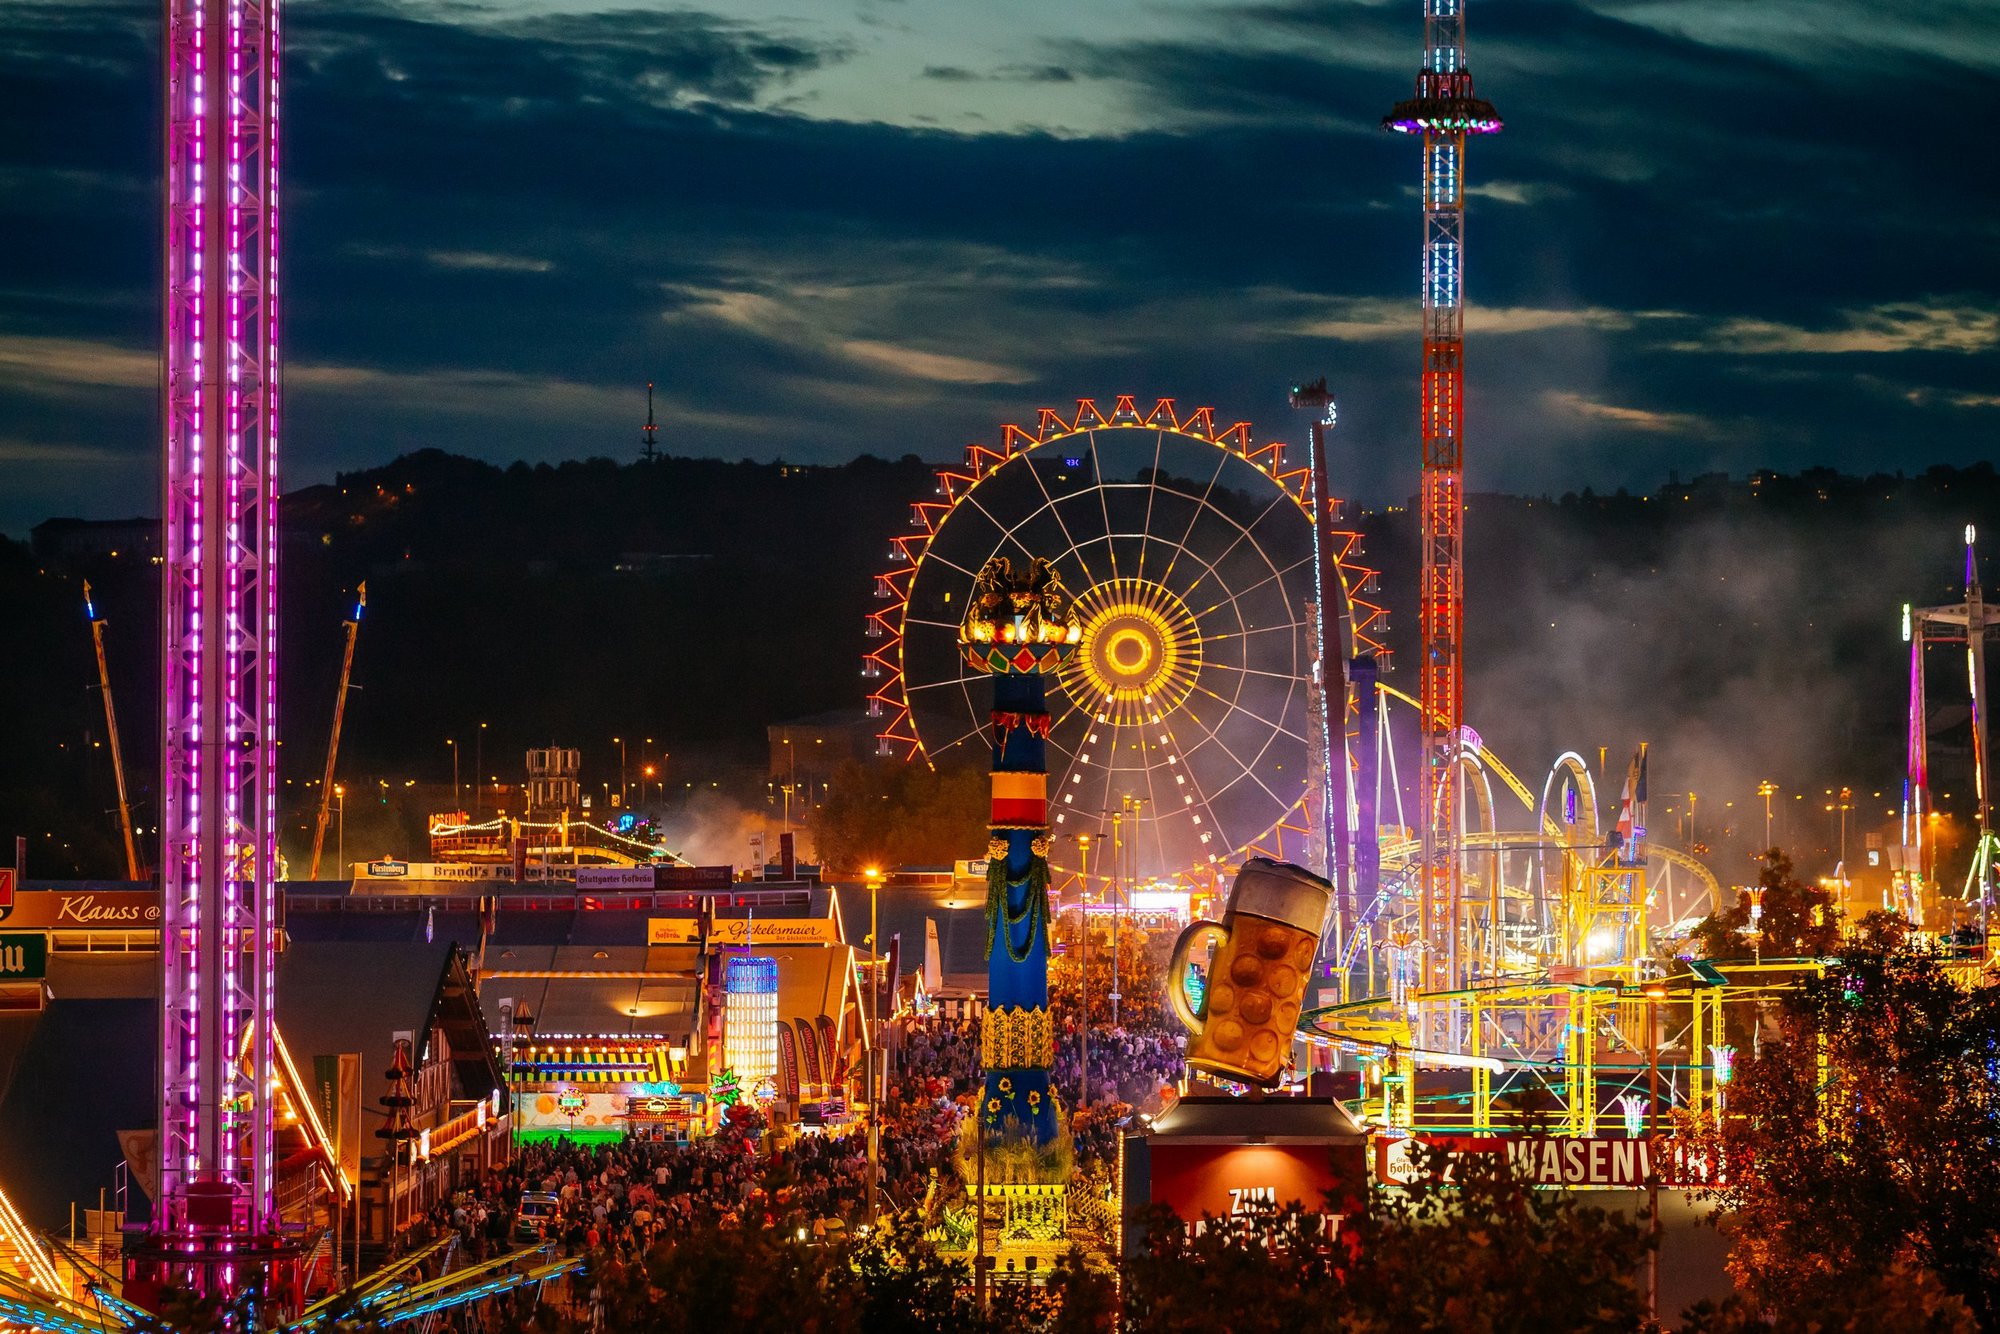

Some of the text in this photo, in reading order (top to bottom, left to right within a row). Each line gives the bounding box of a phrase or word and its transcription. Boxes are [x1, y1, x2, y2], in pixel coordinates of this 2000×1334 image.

[371, 863, 405, 874] Fürstenberg
[433, 866, 488, 877] Brandl's
[496, 866, 576, 878] Fütenberg
[696, 869, 724, 880] Merz
[578, 875, 620, 886] Stuttgarter
[621, 873, 652, 885] Hofbräu
[57, 895, 139, 923] Klauss
[655, 930, 680, 940] Hofbräu
[1390, 1163, 1429, 1175] Hofbr
[1443, 1152, 1496, 1182] ZM
[1229, 1187, 1276, 1215] ZUM
